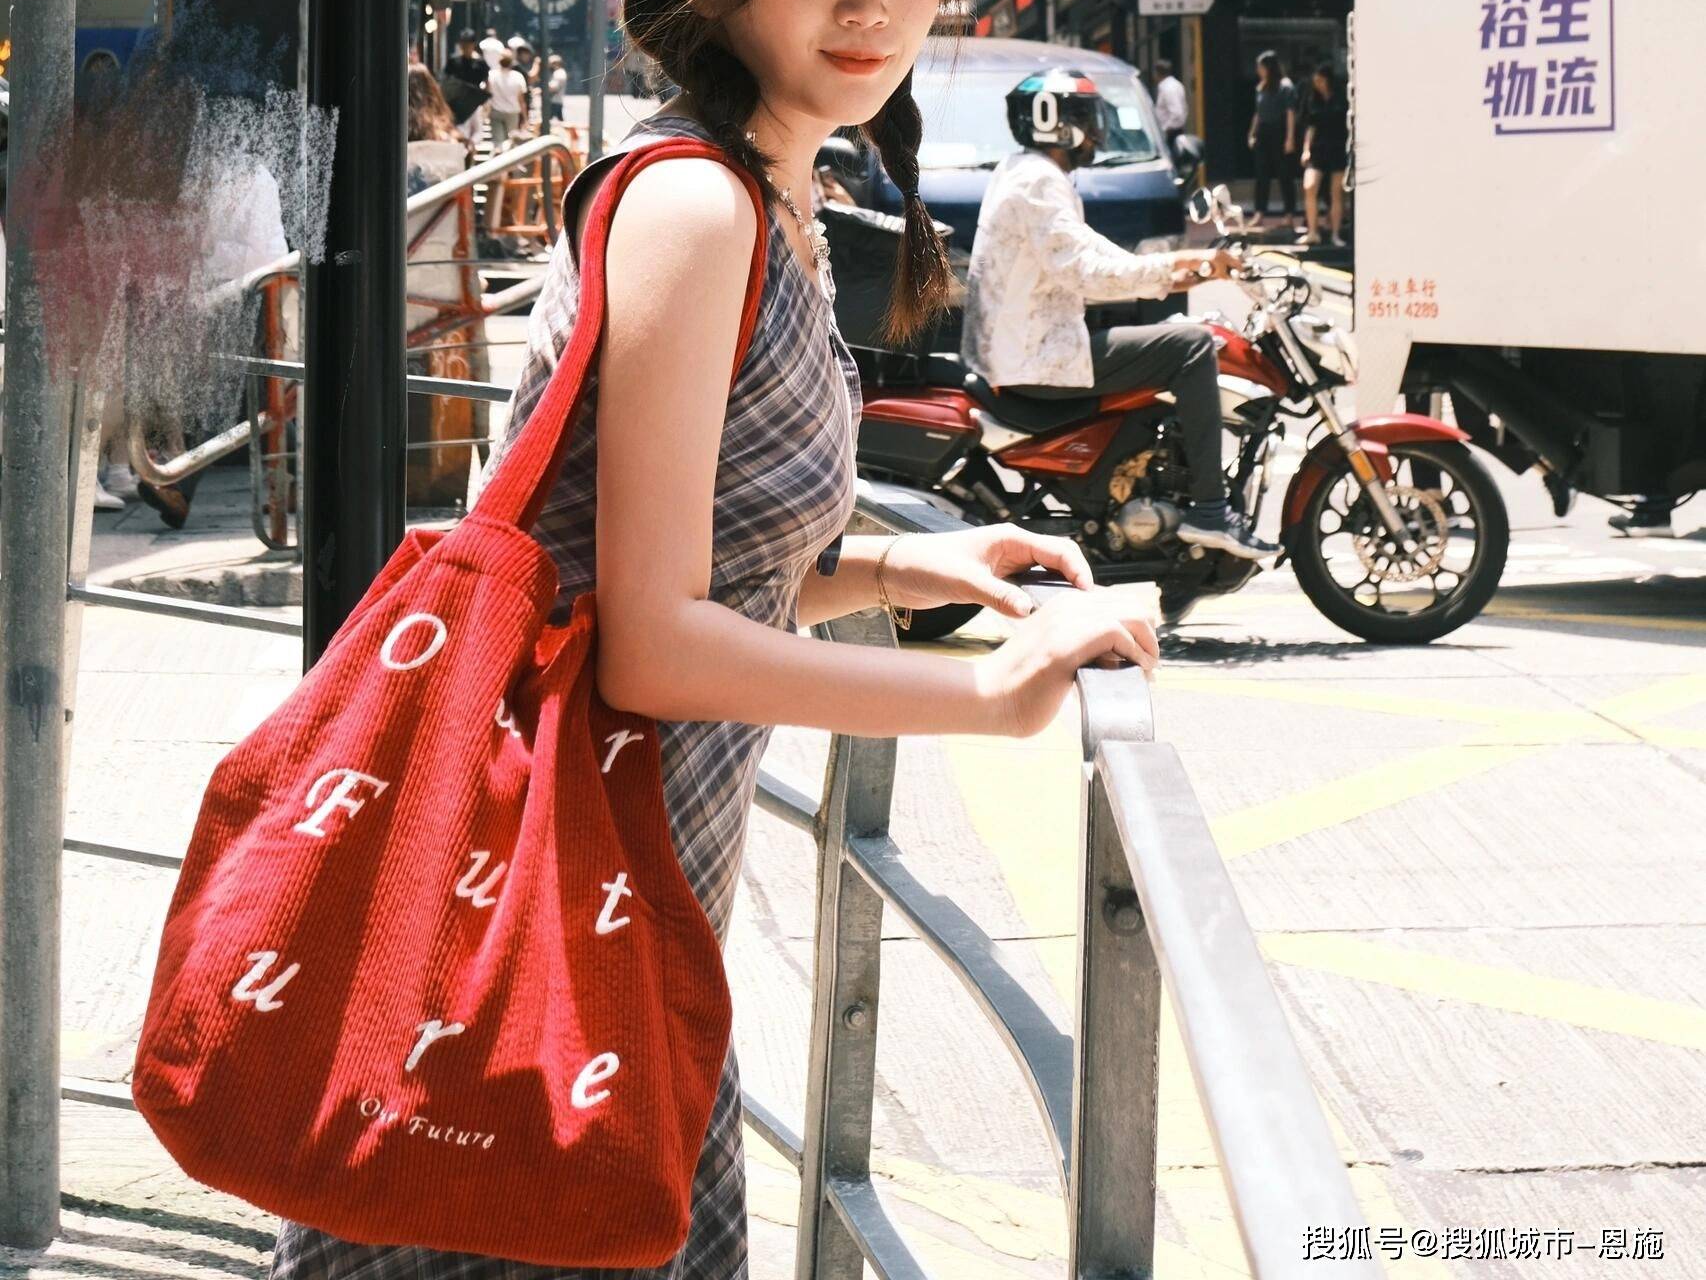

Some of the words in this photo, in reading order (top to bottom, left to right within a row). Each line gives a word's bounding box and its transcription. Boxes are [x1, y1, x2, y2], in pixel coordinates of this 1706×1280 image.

[1483, 56, 1598, 118] 物流
[1368, 302, 1400, 318] 9511
[408, 1115, 496, 1149] Future
